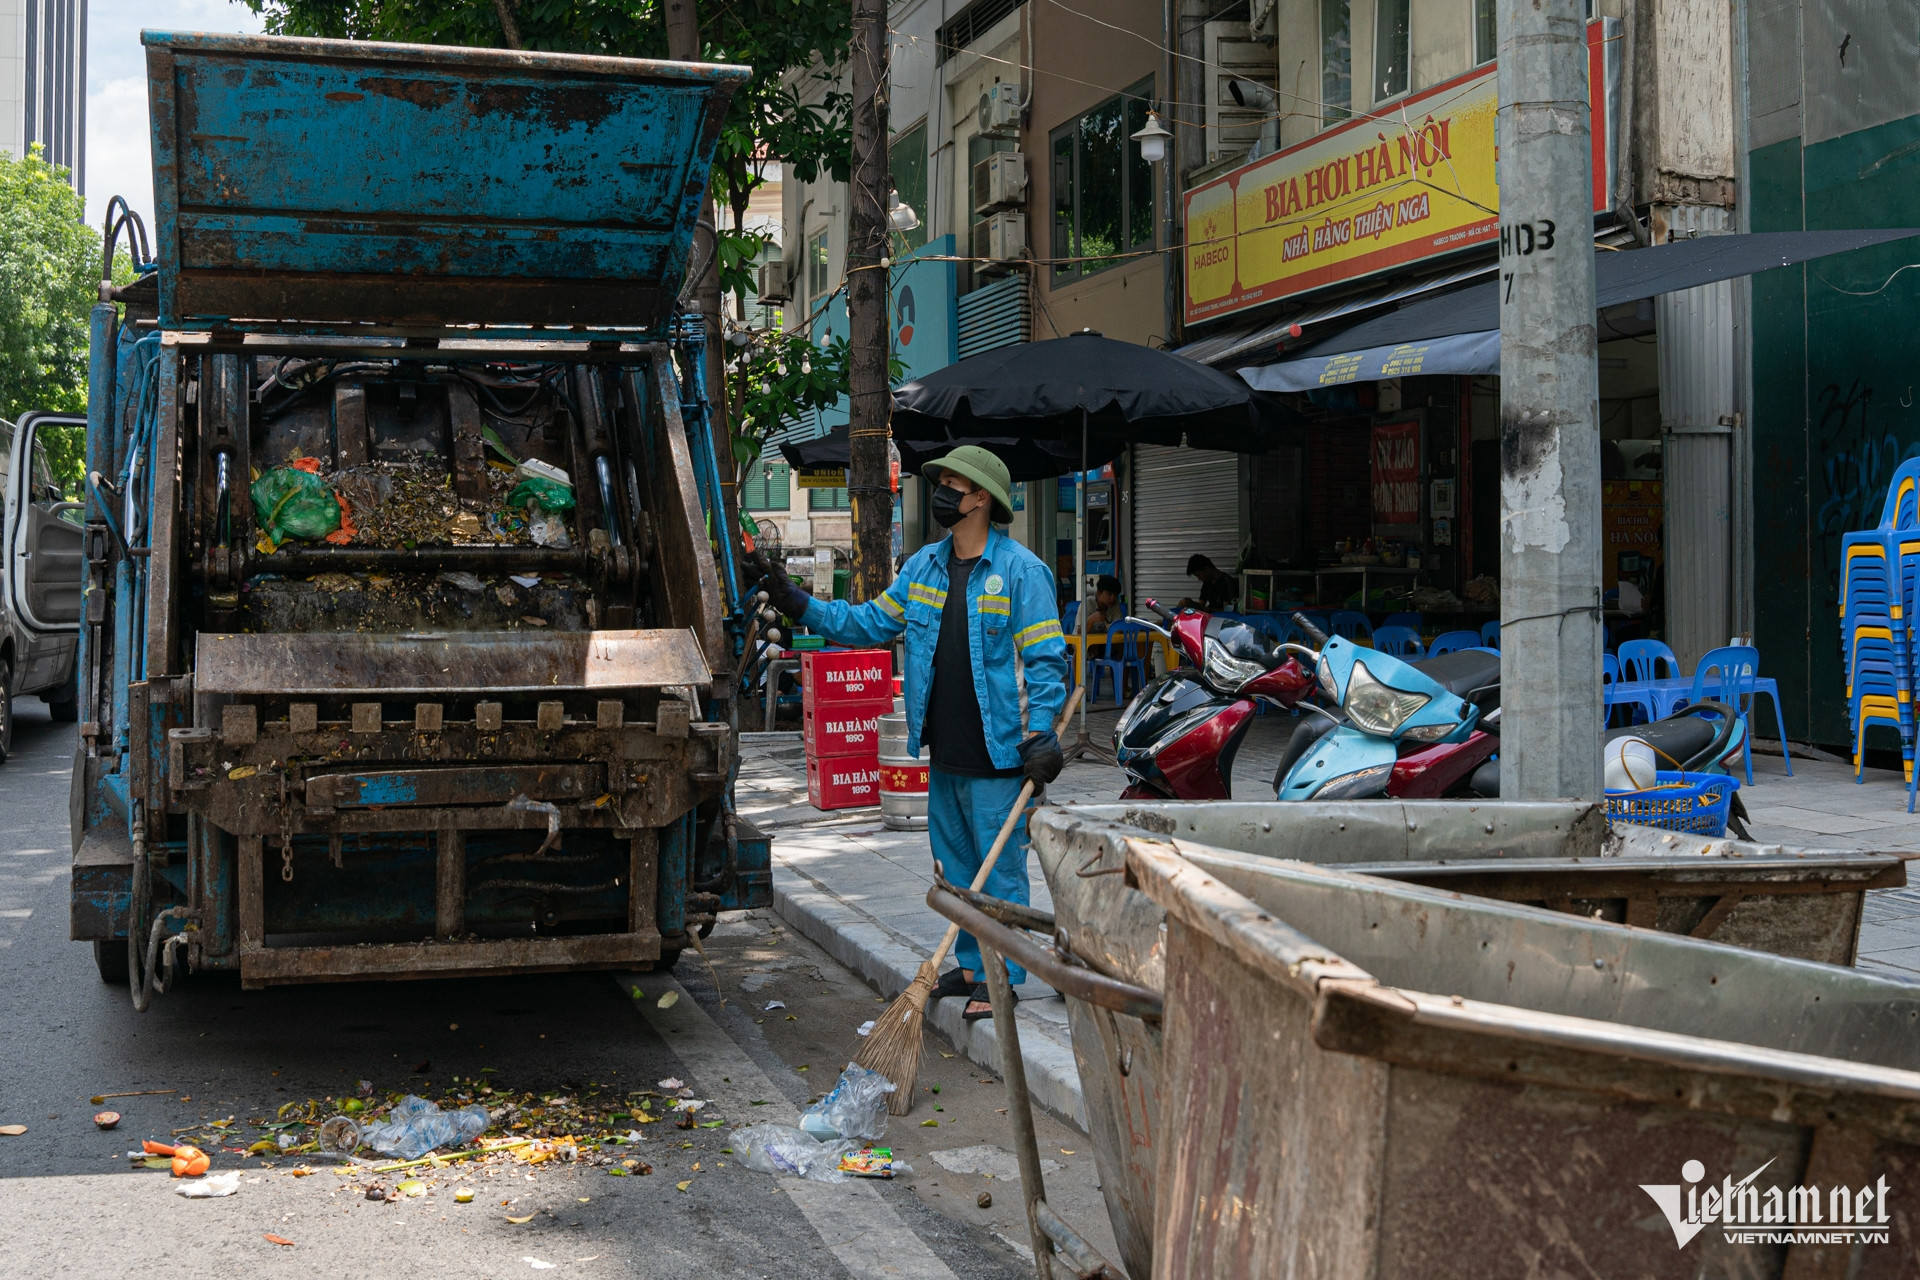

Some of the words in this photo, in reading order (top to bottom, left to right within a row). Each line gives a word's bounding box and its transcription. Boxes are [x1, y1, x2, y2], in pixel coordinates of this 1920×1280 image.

[1264, 177, 1303, 223] BIA
[1304, 156, 1350, 209] HƠI
[1354, 132, 1395, 191] HÀ
[1397, 114, 1451, 177] NỘI
[1283, 226, 1309, 261] NHÀ
[1313, 219, 1350, 252] HÀNG
[1354, 202, 1393, 239] THIỆN
[1397, 192, 1430, 225] NGA
[1433, 236, 1449, 247] HABECO
[1193, 247, 1229, 270] HABECO
[1617, 516, 1631, 525] BIA
[1633, 515, 1649, 525] HƠI
[1610, 529, 1630, 543] HÀ
[826, 671, 845, 682] BIA
[846, 667, 862, 681] HÀ
[863, 667, 882, 682] NỘI
[845, 684, 865, 692] 1890
[826, 721, 845, 733] BIA
[845, 718, 862, 732] HÀ
[863, 717, 878, 732] NỘ
[845, 734, 864, 742] 1890
[832, 773, 851, 786] BIA
[852, 768, 869, 783] HÀ
[851, 785, 871, 794] 1890
